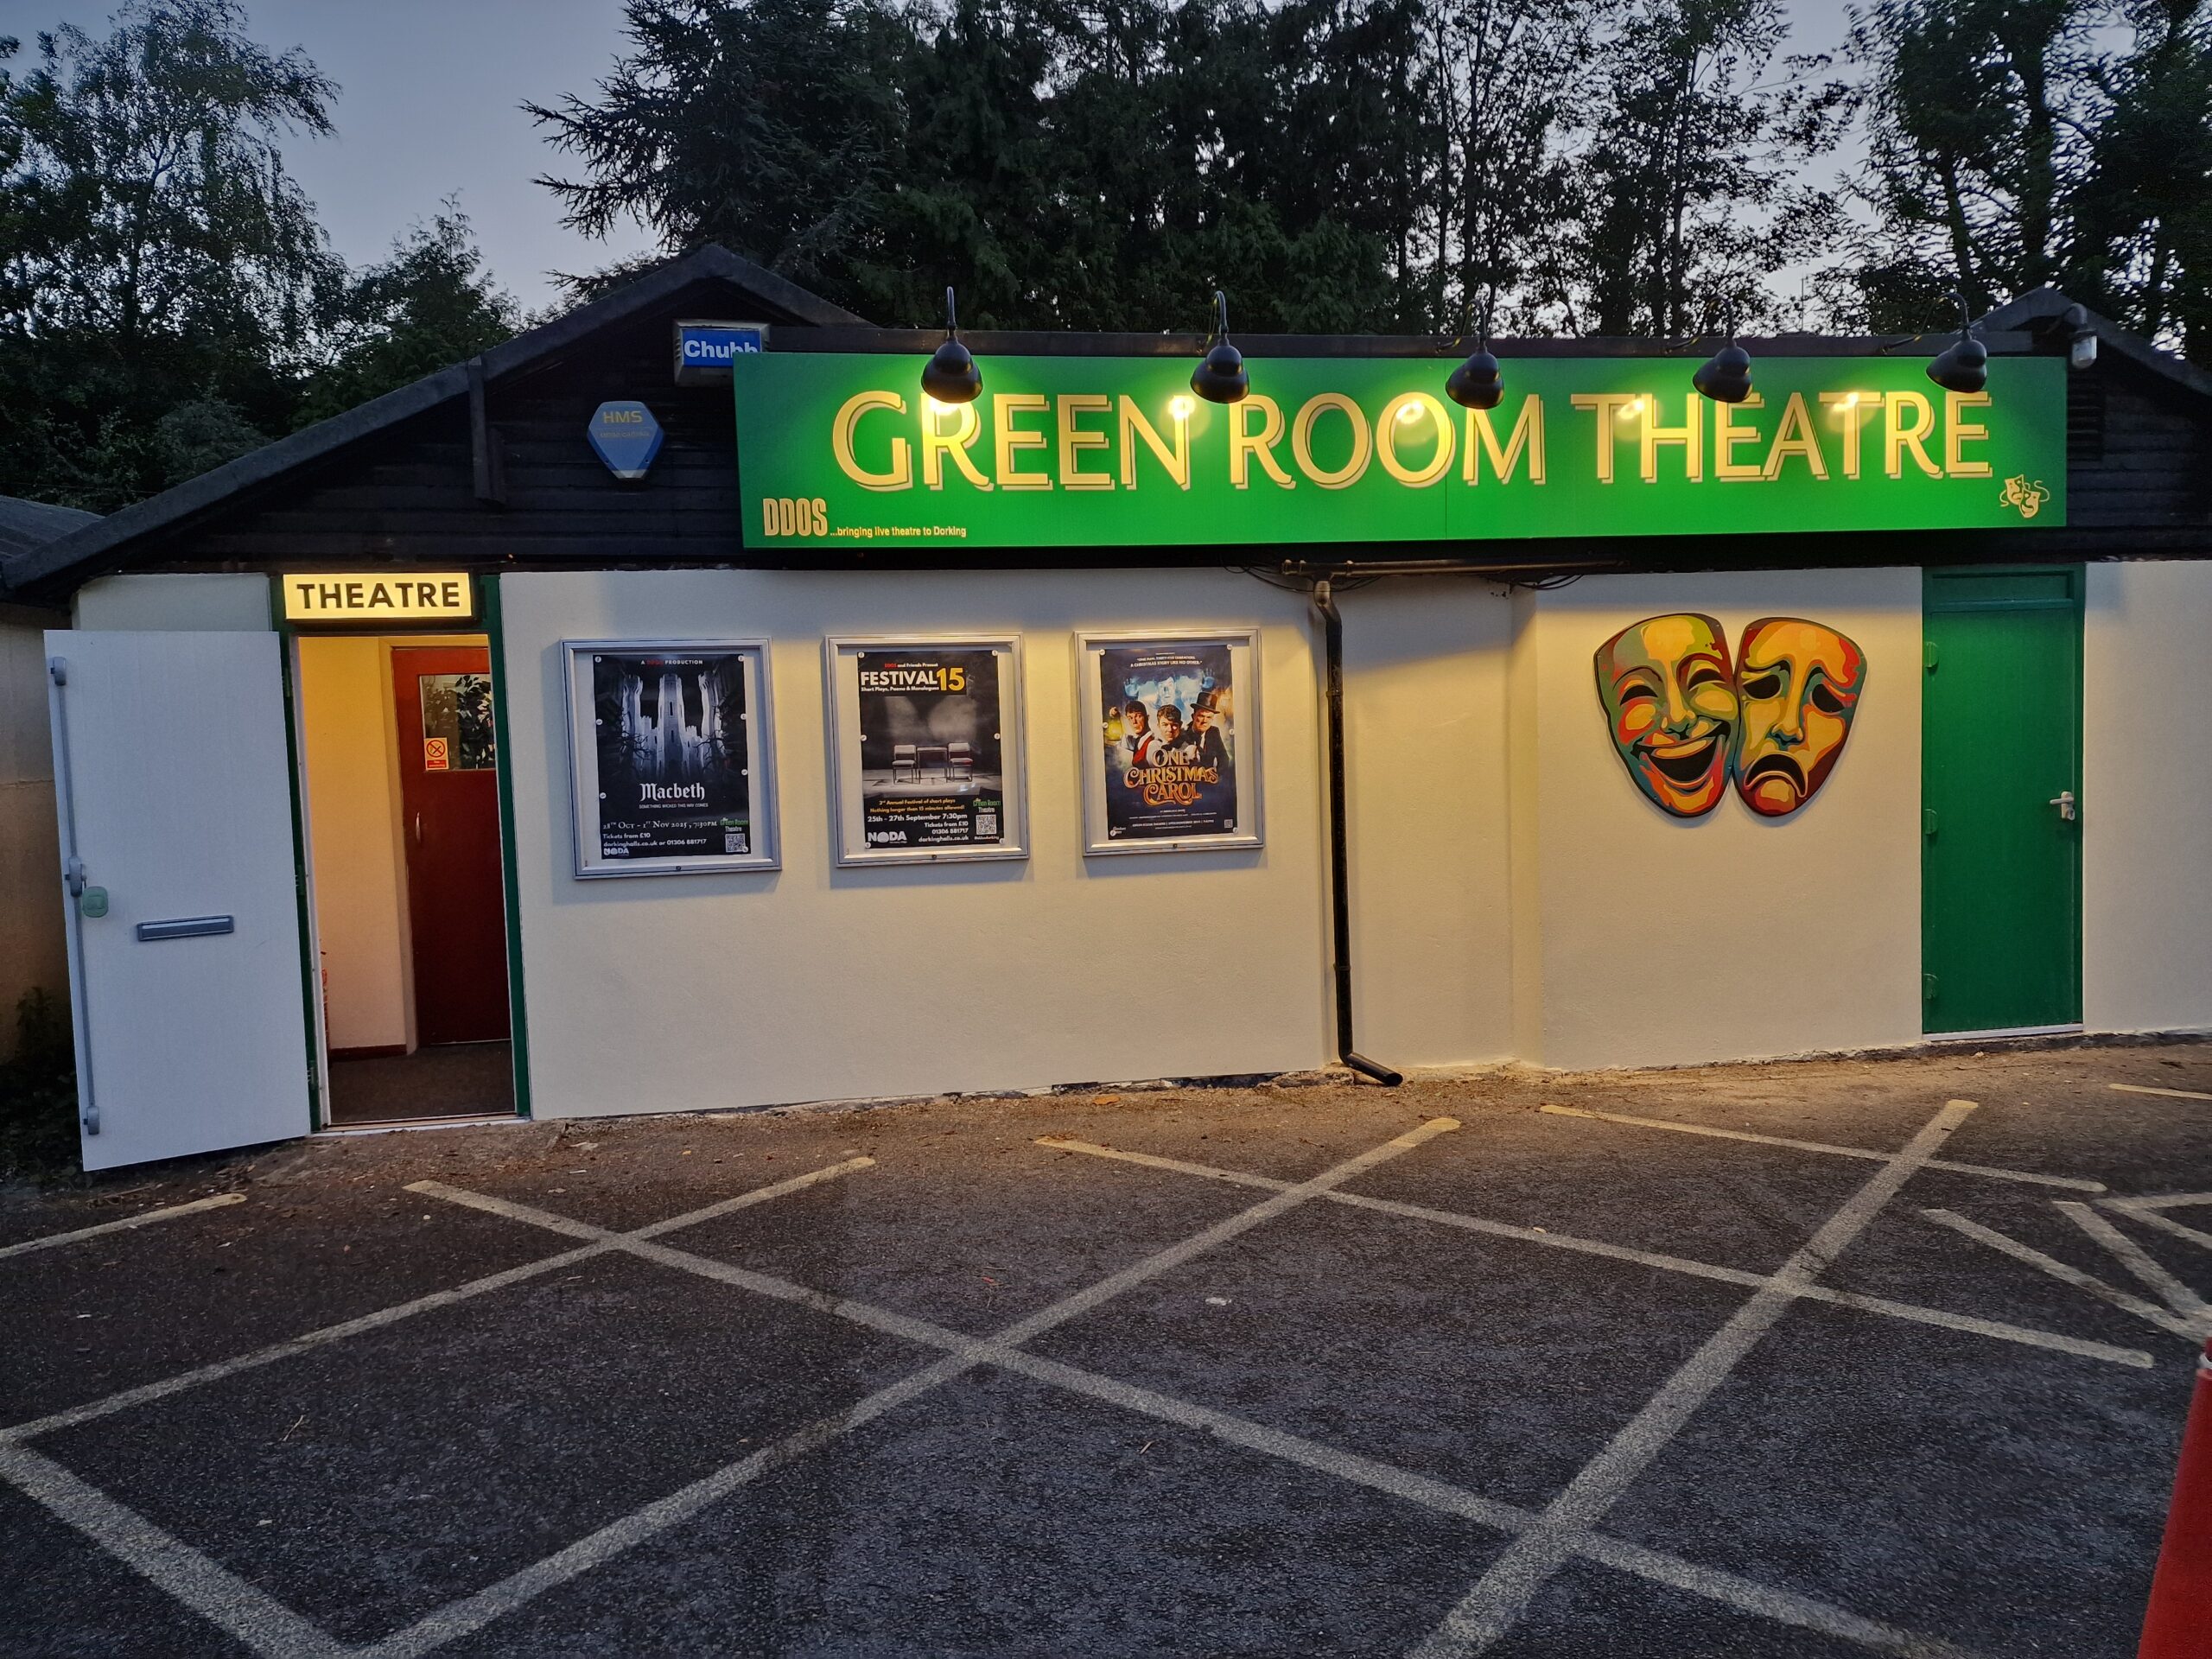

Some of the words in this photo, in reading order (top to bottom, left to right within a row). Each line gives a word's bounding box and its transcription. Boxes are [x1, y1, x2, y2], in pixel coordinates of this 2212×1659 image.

[683, 340, 759, 359] Chubb
[603, 410, 644, 423] HMS
[831, 390, 1191, 492] GREEN
[1227, 391, 1547, 490] ROOM
[1570, 391, 1993, 484] THEATRE
[762, 498, 829, 537] DDOS
[874, 526, 890, 537] live
[892, 526, 921, 537] theatre
[923, 526, 932, 537] to
[933, 525, 967, 537] Dorking
[296, 582, 461, 609] THEATRE
[861, 670, 938, 686] FESTIVAL
[937, 667, 966, 691] 15
[1151, 748, 1191, 767] ONE
[1124, 766, 1219, 789] CHRISTMAS
[639, 782, 706, 802] Macbeth
[1143, 782, 1203, 807] CAROL
[906, 814, 941, 823] September
[942, 812, 968, 821] 7:30pm
